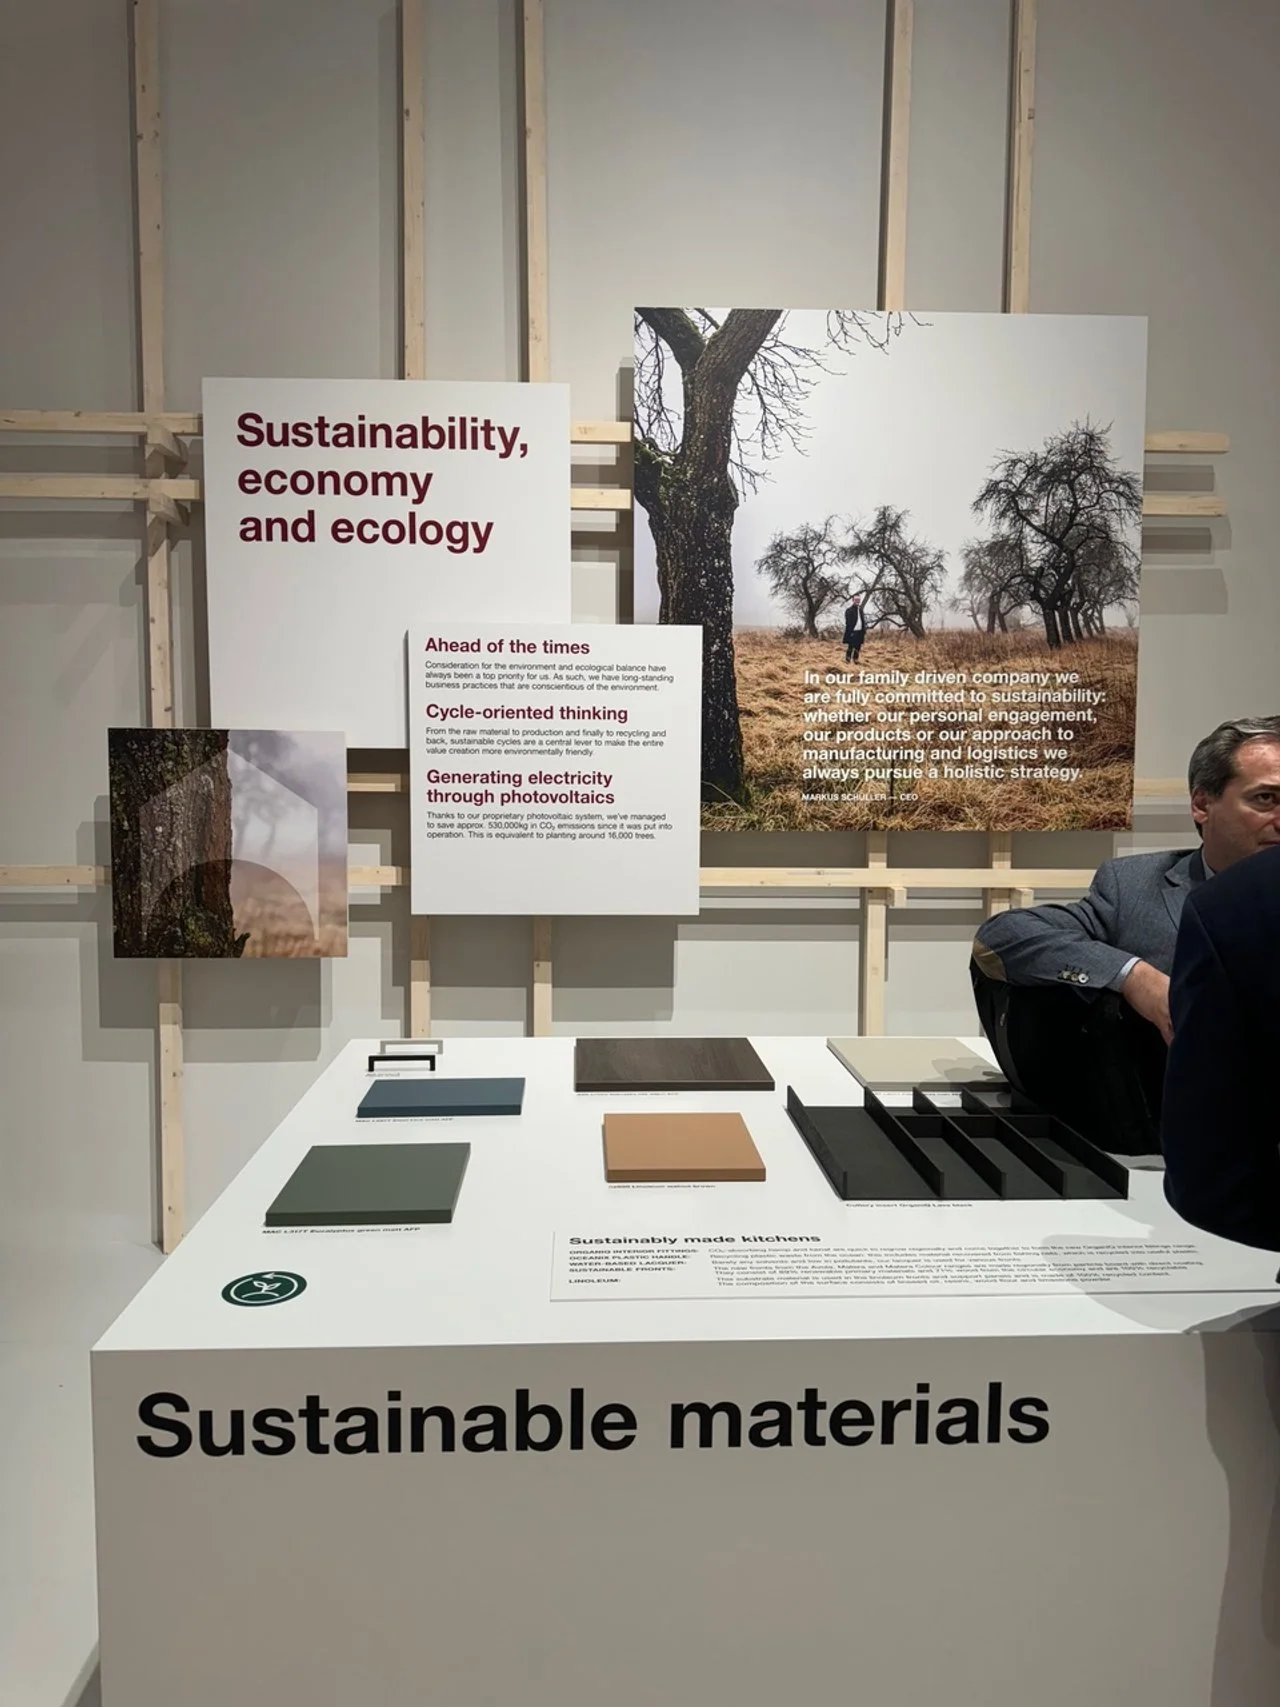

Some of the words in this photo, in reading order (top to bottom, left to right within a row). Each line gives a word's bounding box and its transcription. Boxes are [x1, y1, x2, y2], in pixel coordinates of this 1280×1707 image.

[237, 412, 528, 458] Sustainability,
[238, 469, 433, 504] economy
[238, 509, 316, 542] and
[330, 511, 493, 553] ecology
[425, 637, 480, 652] Ahead
[487, 638, 503, 652] of
[509, 639, 536, 653] the
[543, 639, 589, 654] times
[425, 660, 479, 669] Consideration
[574, 664, 614, 672] ecological
[424, 671, 452, 681] always
[497, 672, 525, 682] priority
[621, 674, 674, 683] long-standing
[805, 670, 820, 684] In
[825, 673, 854, 684] our
[860, 670, 909, 686] family
[915, 670, 966, 684] driven
[972, 672, 1050, 686] company
[1055, 672, 1080, 684] we
[804, 692, 831, 704] are
[836, 690, 870, 706] fully
[874, 690, 964, 703] committed
[970, 690, 986, 702] to
[991, 689, 1106, 705] sustainability:
[426, 703, 554, 722] Cycle-oriented
[560, 706, 628, 723] thinking
[804, 709, 872, 722] whether
[877, 711, 904, 722] our
[910, 708, 982, 724] personal
[988, 708, 1098, 724] engagement,
[478, 728, 510, 738] material
[581, 729, 604, 737] finally
[615, 730, 650, 738] recycling
[803, 730, 832, 742] our
[836, 728, 911, 744] products
[916, 730, 934, 741] or
[939, 730, 968, 740] our
[972, 727, 1052, 744] approach
[1058, 728, 1074, 740] to
[495, 738, 521, 746] cycles
[641, 738, 664, 746] entire
[503, 748, 564, 756] environmentally
[804, 746, 924, 763] manufacturing
[930, 746, 962, 760] and
[968, 746, 1038, 762] logistics
[1043, 748, 1068, 760] we
[426, 769, 522, 787] Generating
[528, 770, 613, 787] electricity
[802, 766, 859, 782] always
[864, 768, 923, 782] pursue
[928, 768, 938, 779] a
[944, 765, 1005, 778] holistic
[1010, 765, 1083, 781] strategy.
[427, 789, 494, 806] through
[501, 789, 614, 806] photovoltaics
[481, 813, 525, 822] proprietary
[526, 812, 573, 822] photovoltaic
[545, 832, 577, 840] planting
[138, 1387, 636, 1457] Sustainable
[670, 1381, 1049, 1448] materials
